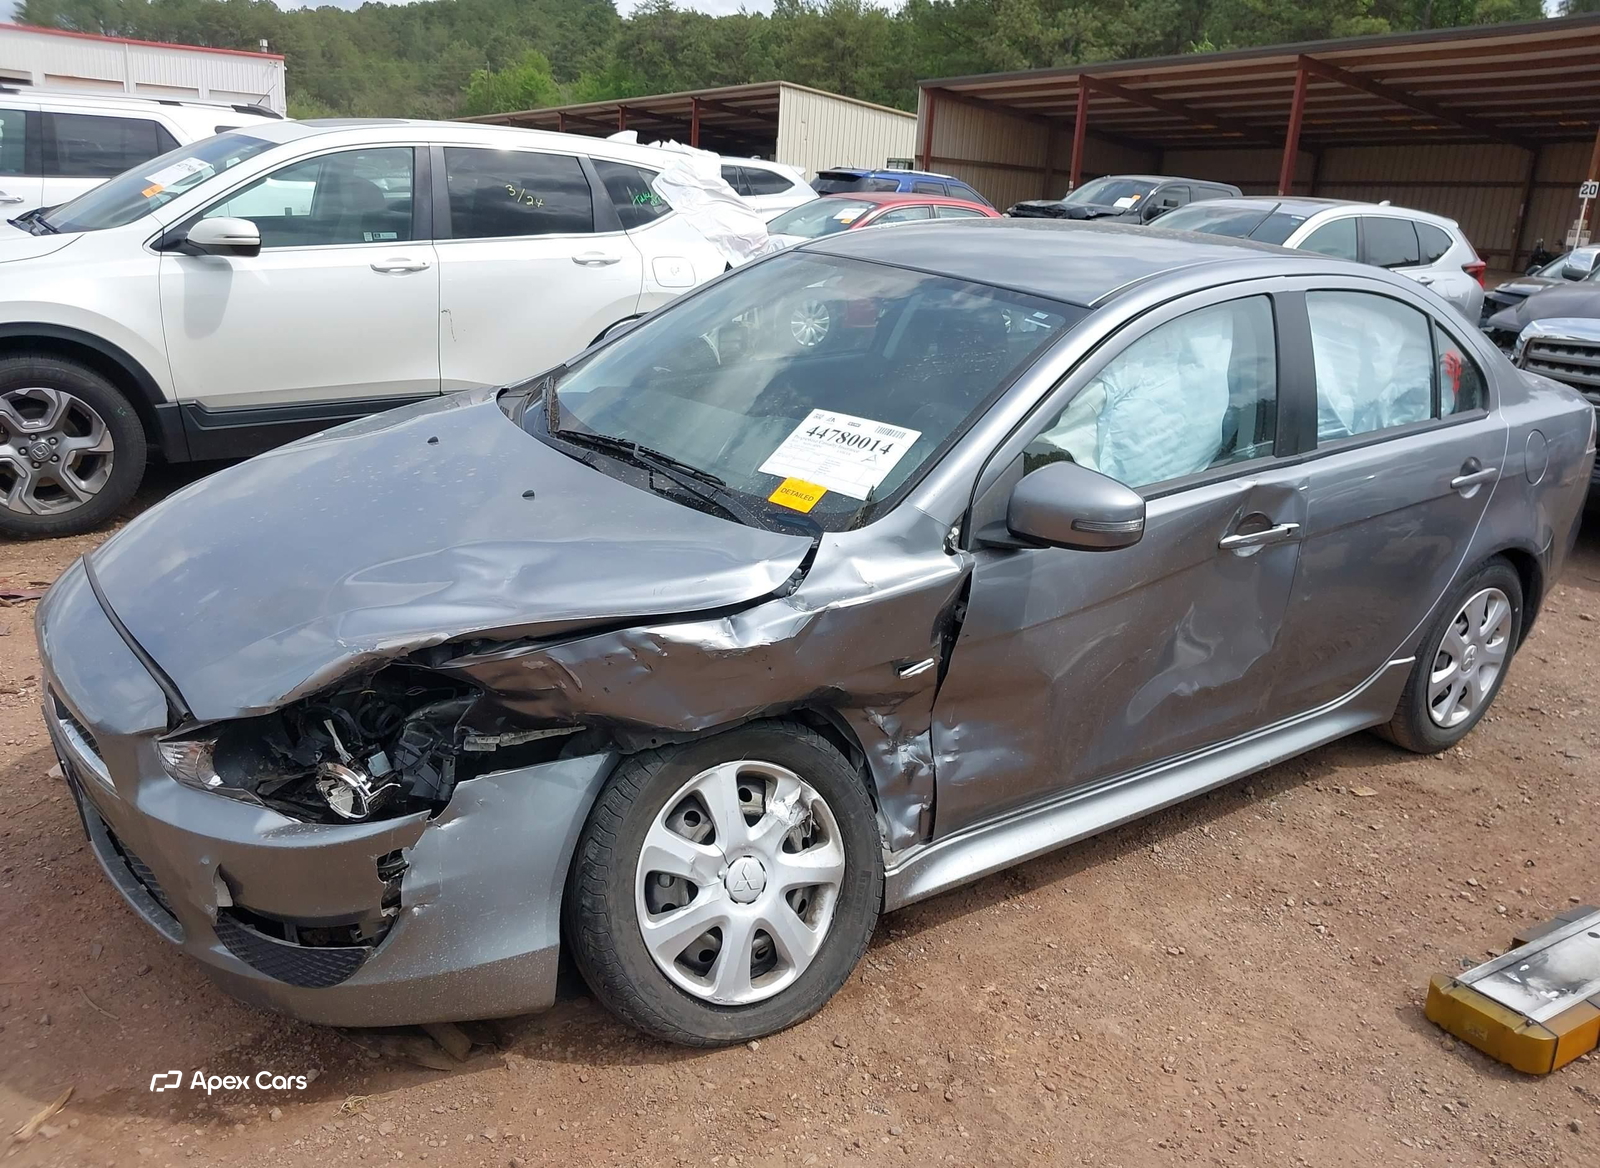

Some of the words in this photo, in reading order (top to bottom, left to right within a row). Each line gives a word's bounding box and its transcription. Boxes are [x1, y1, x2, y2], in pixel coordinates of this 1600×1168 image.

[1580, 184, 1597, 196] 20
[806, 425, 895, 455] 44780014
[780, 487, 815, 502] DETAILED
